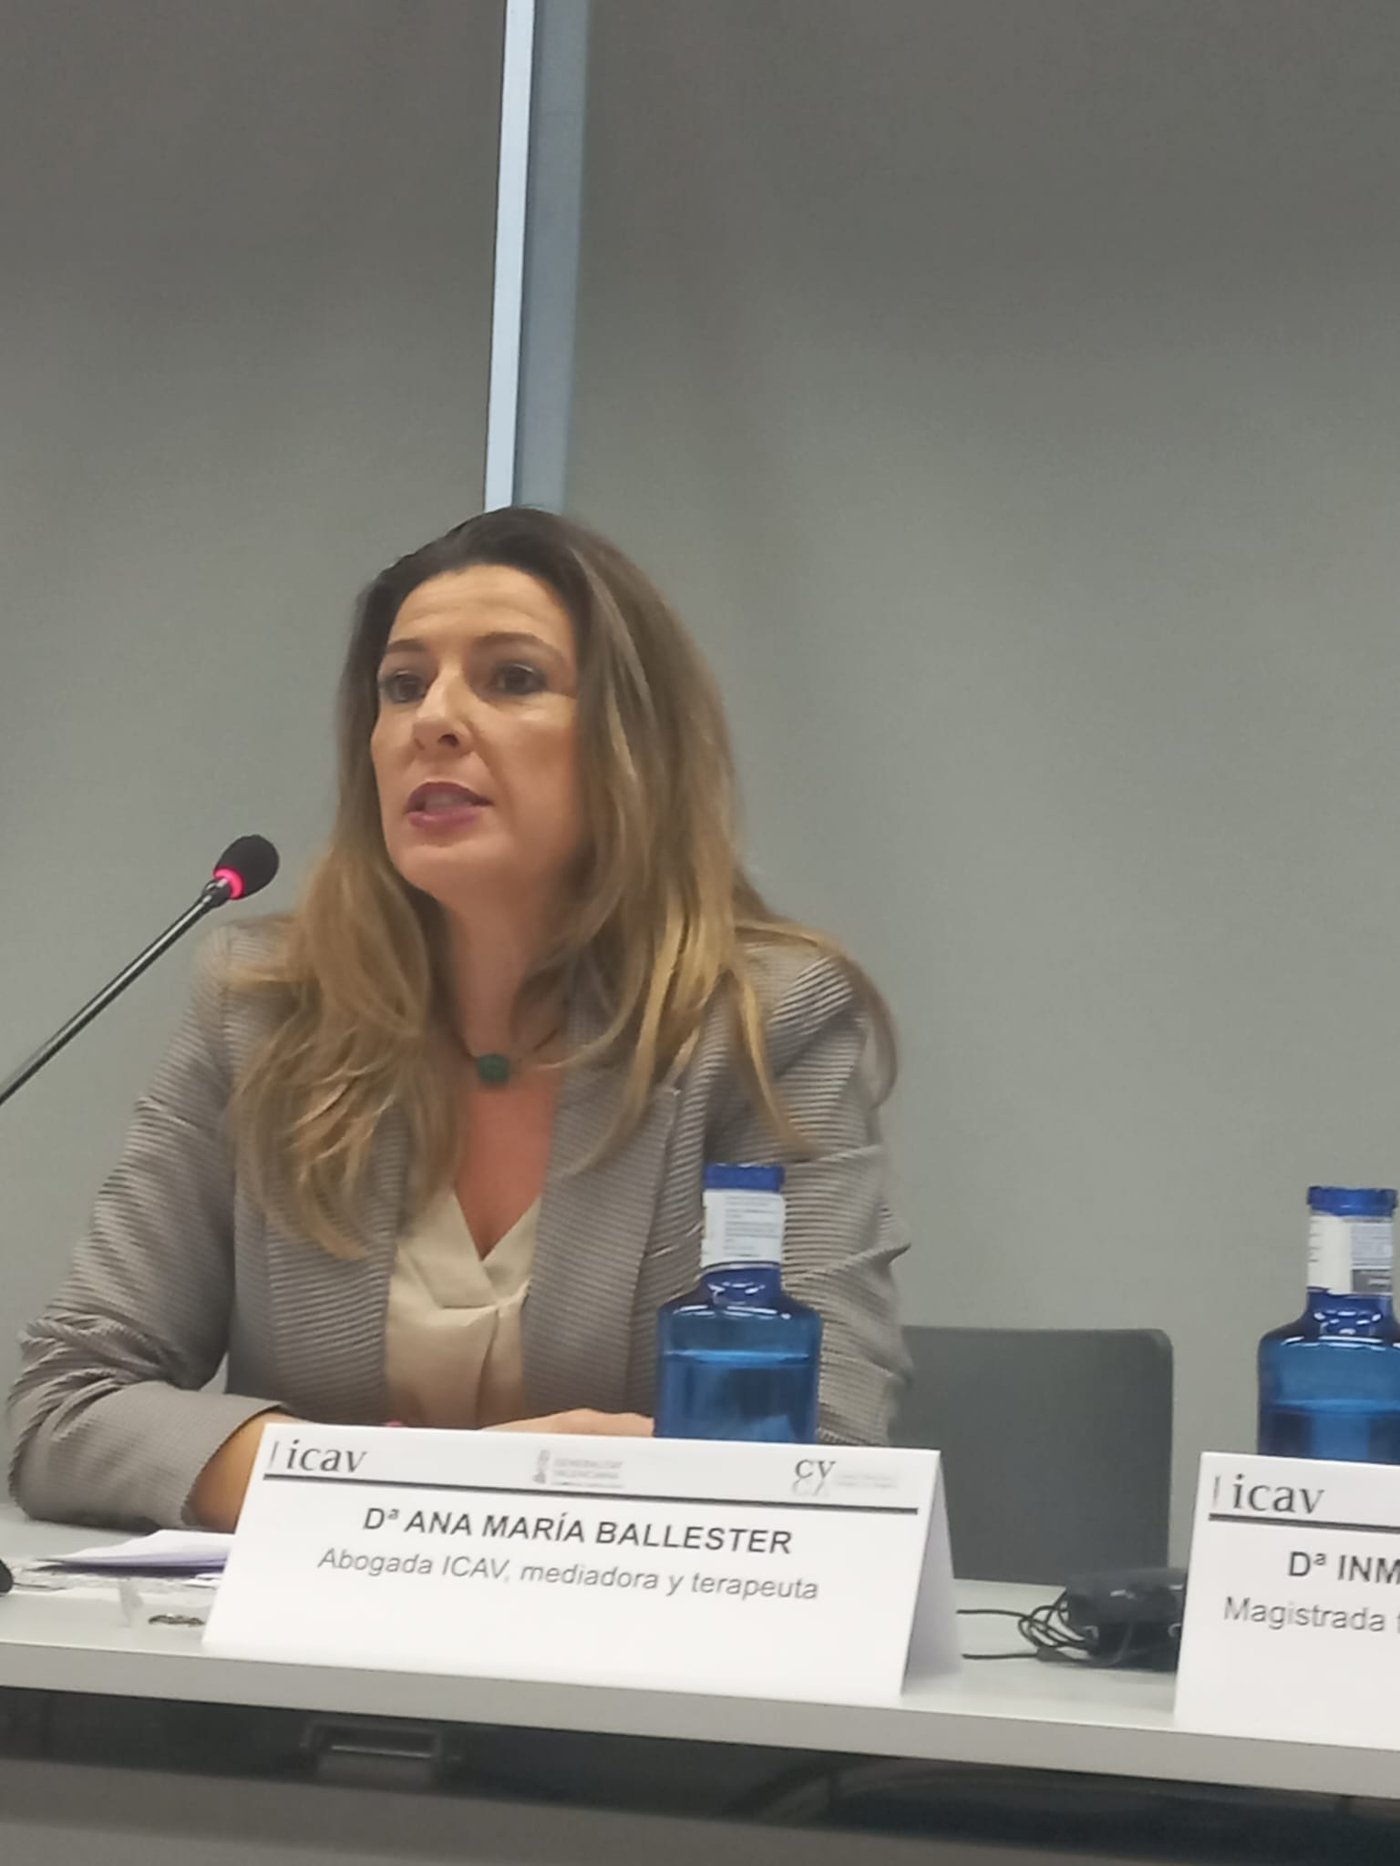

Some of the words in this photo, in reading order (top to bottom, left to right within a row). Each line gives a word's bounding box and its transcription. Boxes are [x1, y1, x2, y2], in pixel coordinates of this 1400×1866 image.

[286, 1439, 368, 1473] icav
[1233, 1473, 1325, 1514] icav
[403, 1510, 472, 1536] ANA
[482, 1513, 584, 1544] MARÍA
[596, 1520, 792, 1554] BALLESTER
[317, 1547, 434, 1577] Abogada
[441, 1555, 510, 1583] ICAV,
[520, 1564, 659, 1591] mediadora
[665, 1574, 684, 1597] y
[690, 1571, 820, 1601] terapeuta
[1224, 1595, 1384, 1630] Magistrada
